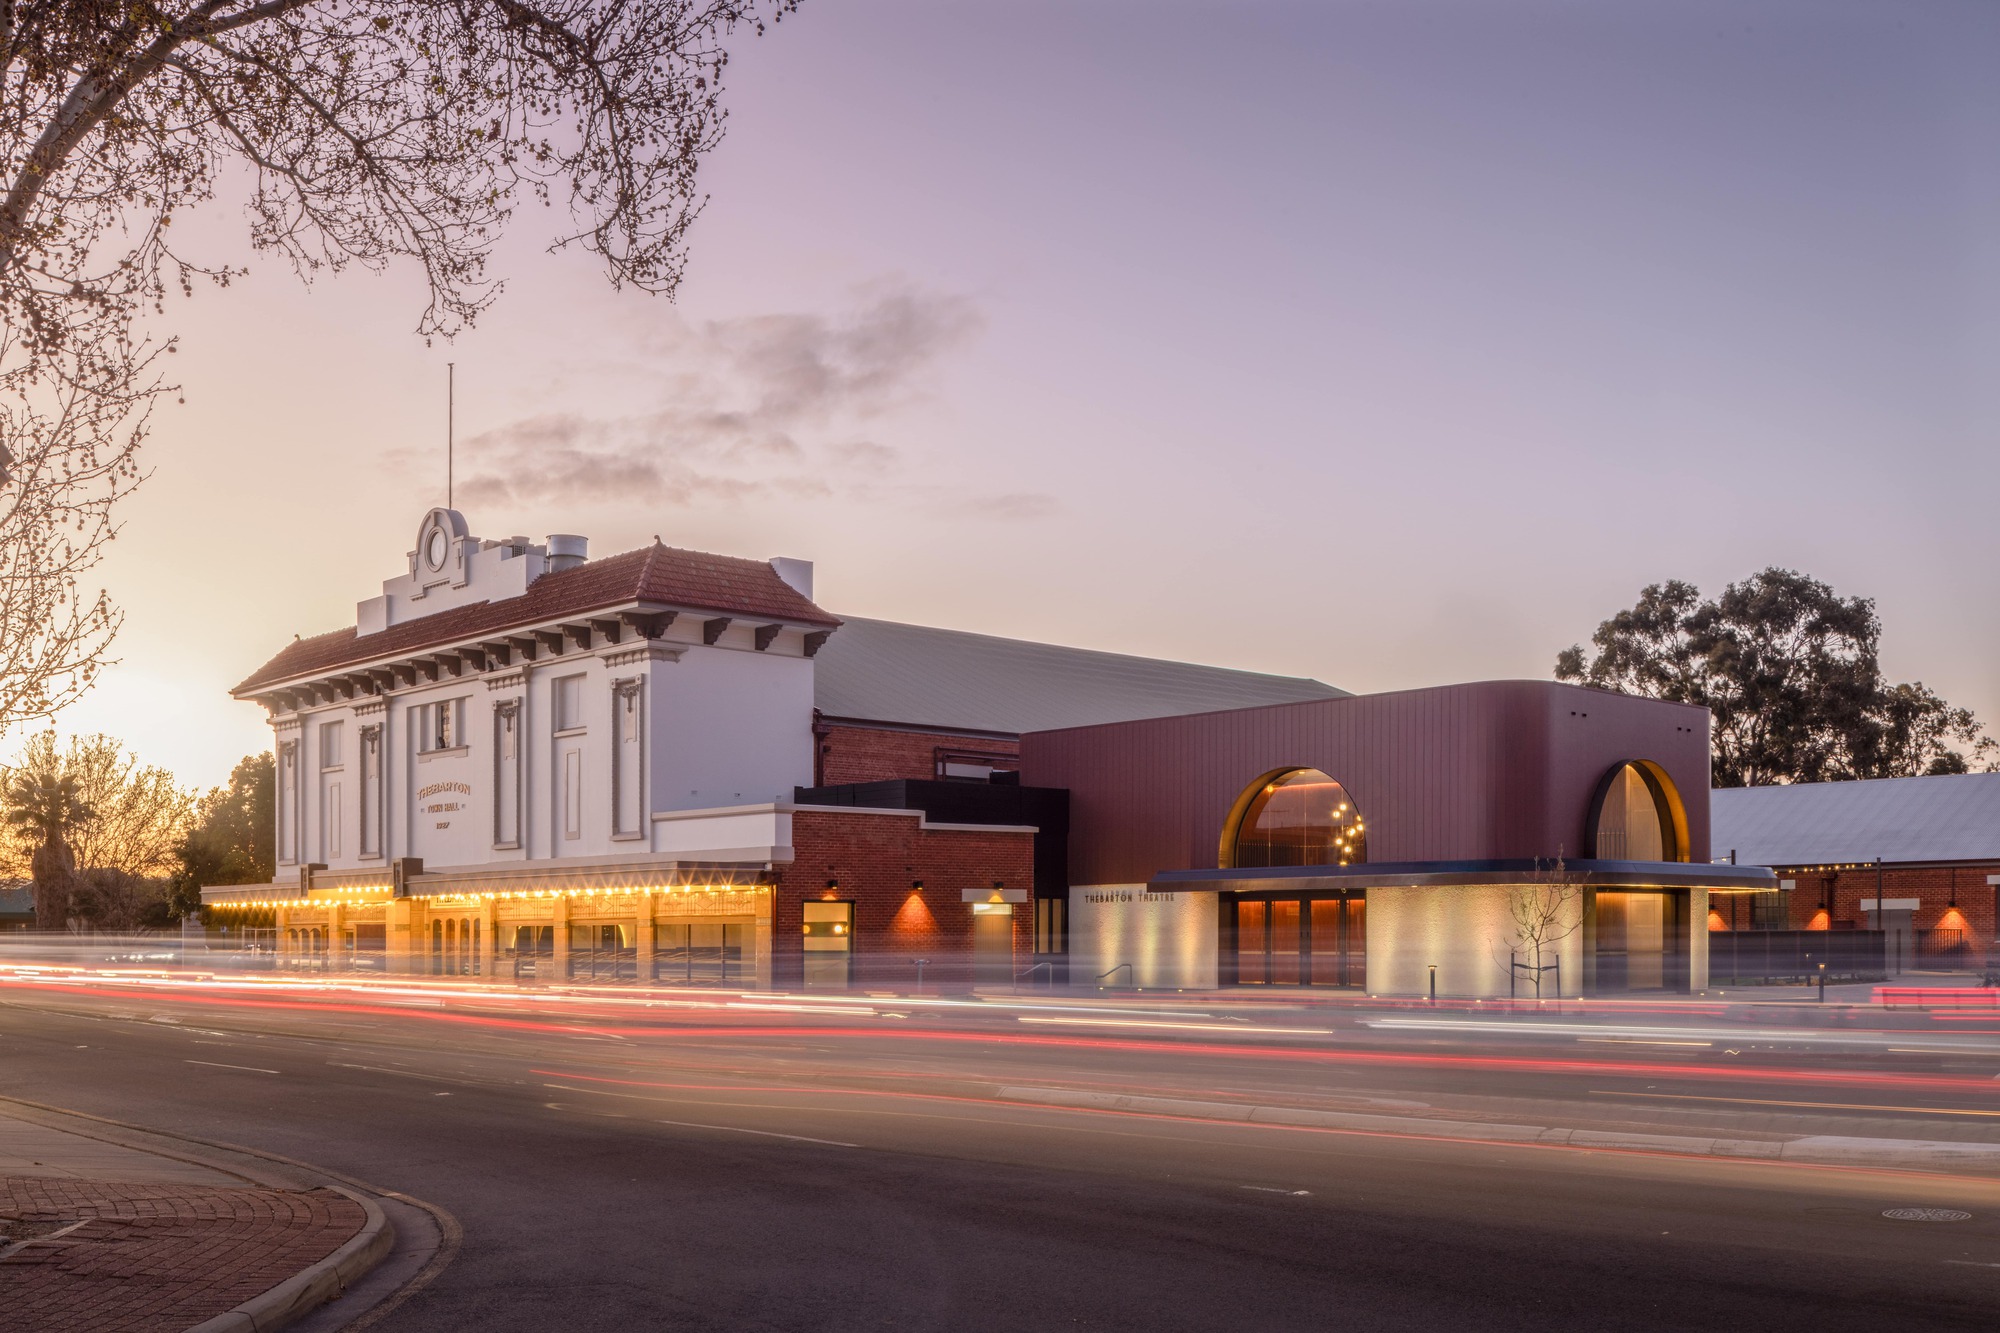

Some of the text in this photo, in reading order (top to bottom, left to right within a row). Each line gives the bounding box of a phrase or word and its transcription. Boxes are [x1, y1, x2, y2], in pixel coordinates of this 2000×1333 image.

[417, 781, 471, 801] THEBARTON
[428, 802, 460, 813] TOWN HALL
[1085, 893, 1175, 903] THEBARTON THEATRE
